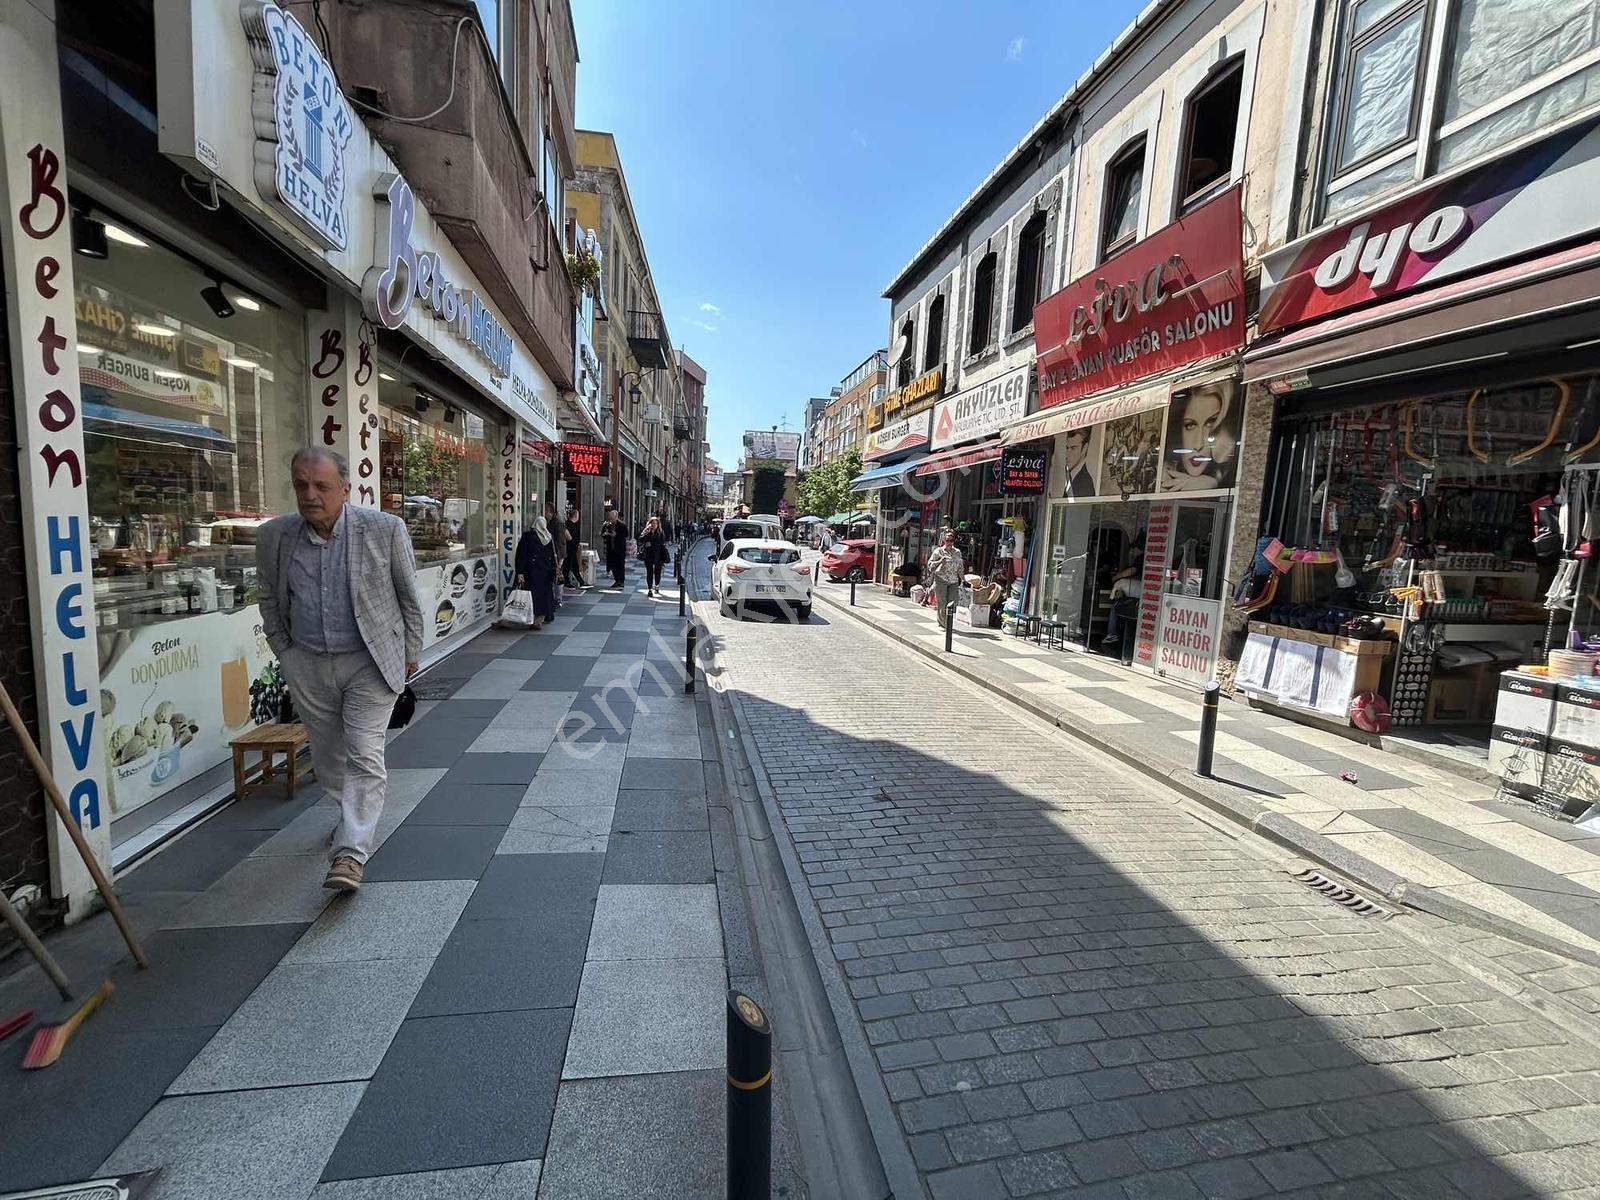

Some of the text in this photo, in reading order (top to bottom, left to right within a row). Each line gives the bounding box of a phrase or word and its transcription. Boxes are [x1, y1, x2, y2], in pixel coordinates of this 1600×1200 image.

[273, 26, 348, 138] BETON
[284, 163, 344, 239] HELVA
[377, 174, 471, 341] Beton
[1314, 205, 1470, 289] dyo
[1040, 301, 1234, 393] BAY & BAYAN KUAFÖR SALONU
[312, 328, 345, 446] Bet
[955, 374, 1024, 421] AKYÜZLER
[19, 143, 101, 833] Beton HELVA
[571, 462, 600, 474] TAVA
[1163, 626, 1211, 653] KUAFÖR
[1169, 607, 1209, 630] BAYAN
[130, 644, 200, 685] DONDURMA
[1161, 647, 1208, 674] SALONU
